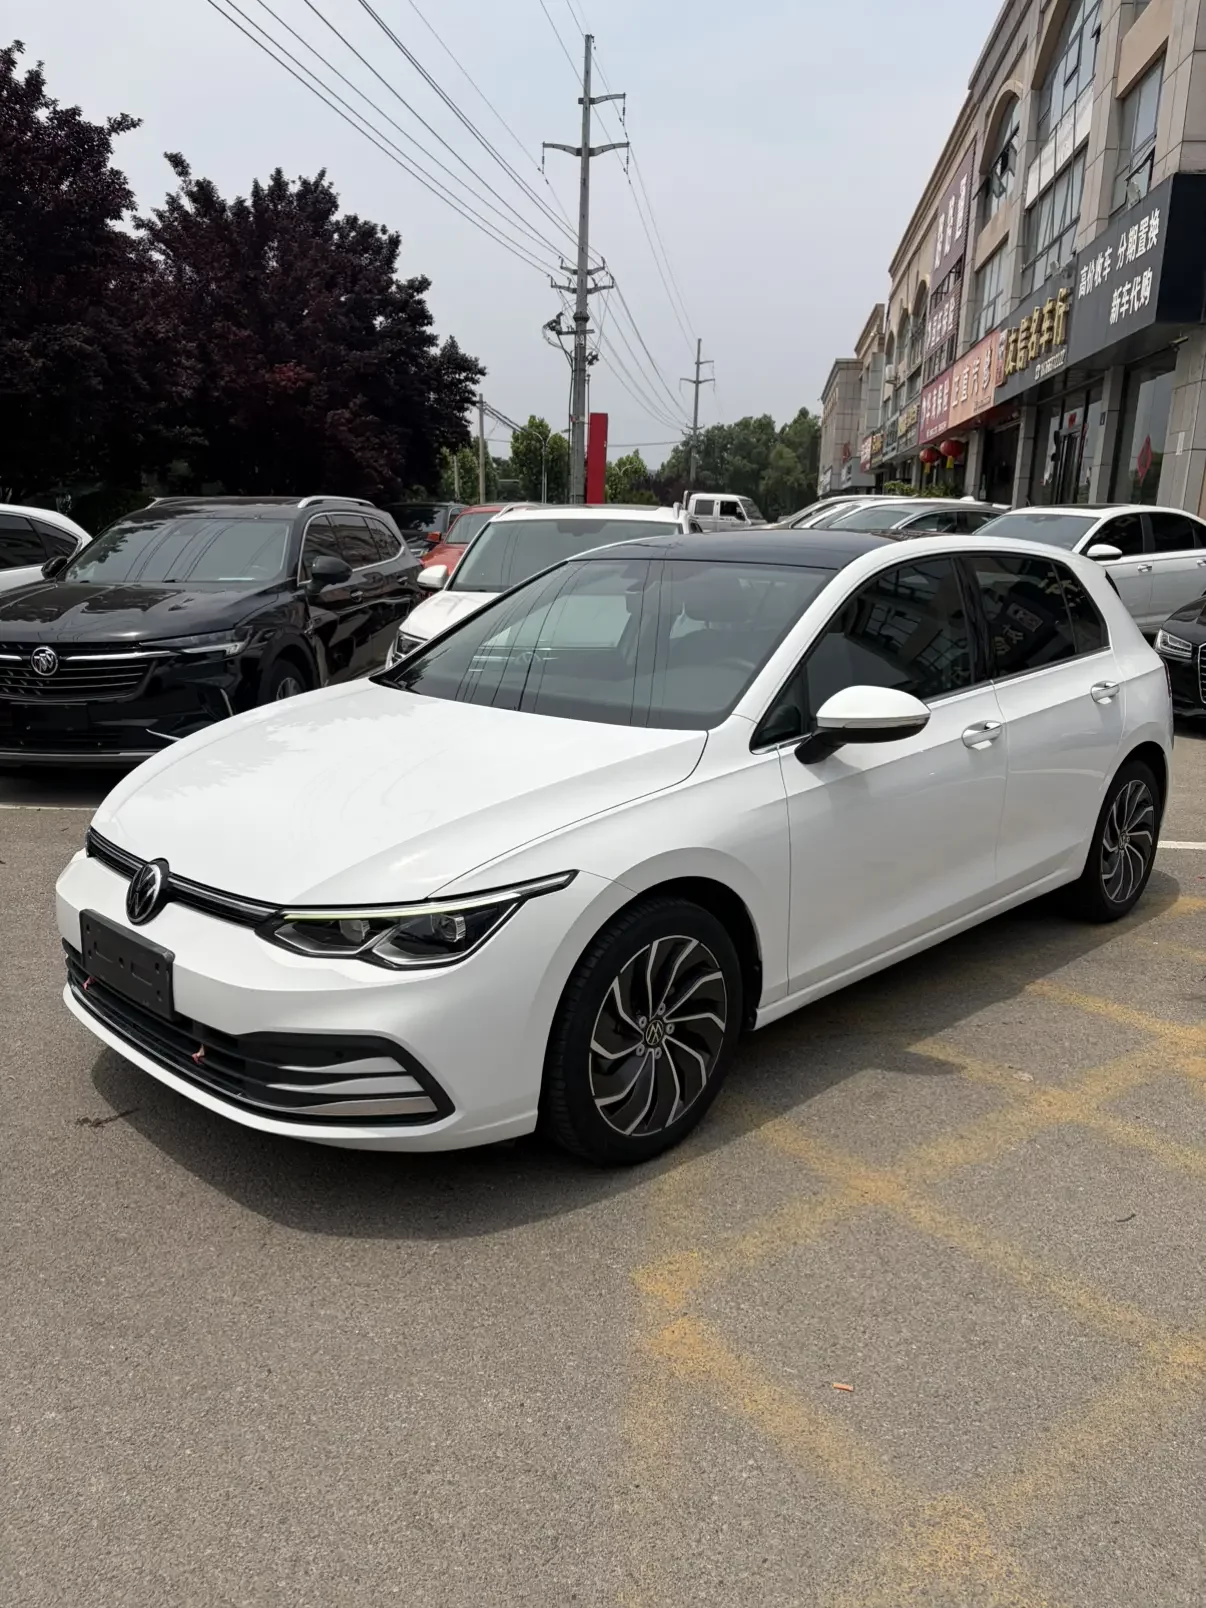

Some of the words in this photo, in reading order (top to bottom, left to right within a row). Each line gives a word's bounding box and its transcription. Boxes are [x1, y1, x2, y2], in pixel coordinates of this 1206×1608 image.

[1078, 246, 1113, 300] 高价收车
[1116, 207, 1160, 271] 分期置换
[1109, 267, 1153, 325] 新车代购
